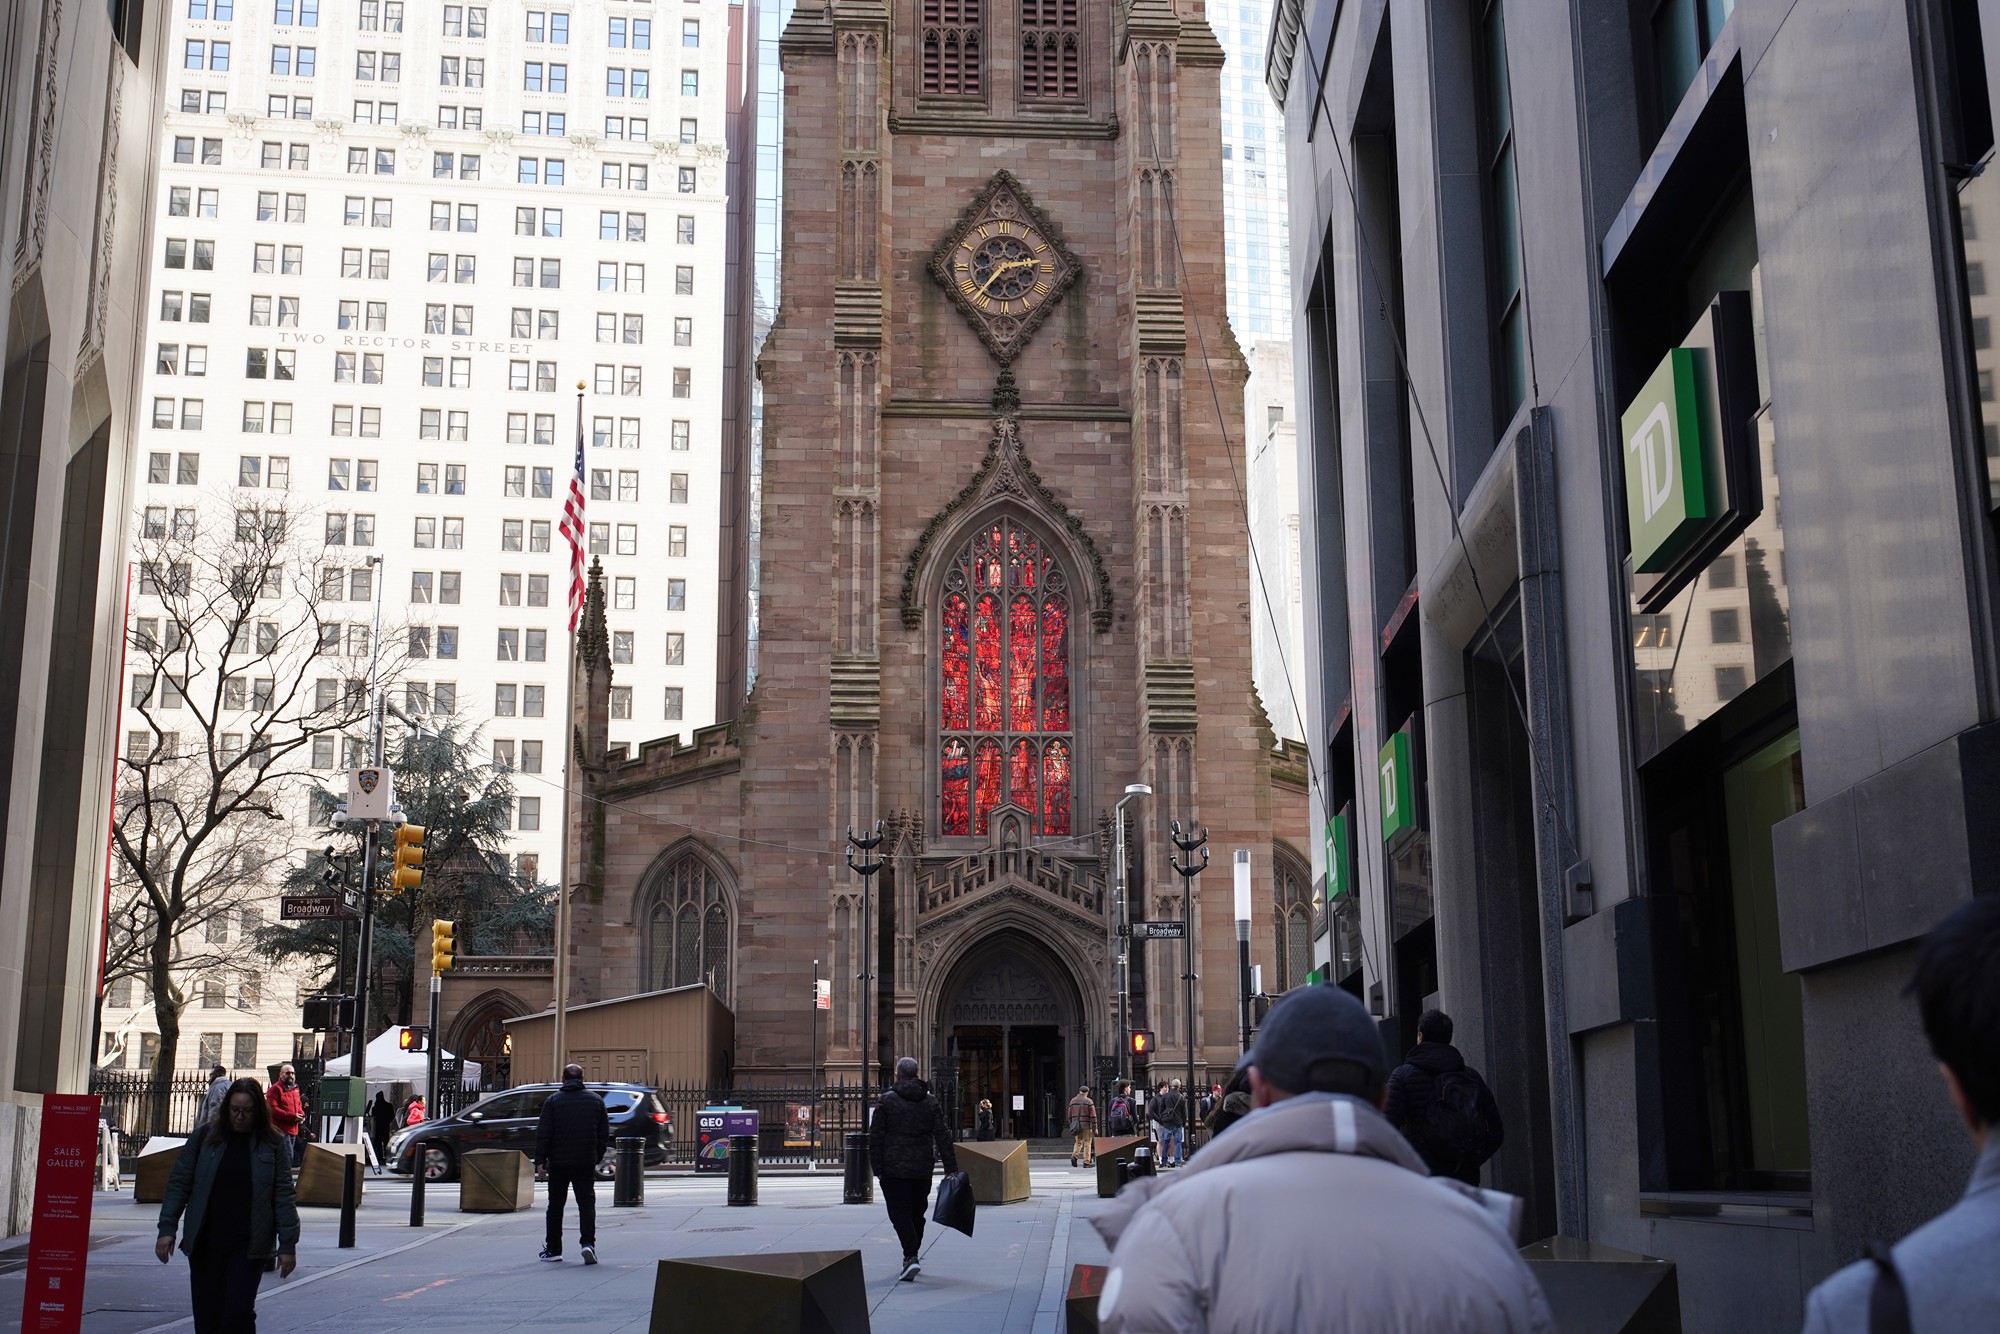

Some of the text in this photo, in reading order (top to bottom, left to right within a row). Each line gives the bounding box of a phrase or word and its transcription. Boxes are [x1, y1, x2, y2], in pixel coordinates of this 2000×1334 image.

[999, 222, 1010, 234] XII
[279, 332, 533, 354] TWO RECTOR STREET
[1630, 401, 1673, 524] TD
[1381, 757, 1396, 818] TD
[1326, 837, 1337, 883] TD
[287, 903, 331, 915] Broadway
[1149, 927, 1181, 936] Broadway
[700, 1117, 723, 1127] GEO
[54, 1147, 80, 1156] SALES
[46, 1159, 85, 1168] GALLERY
